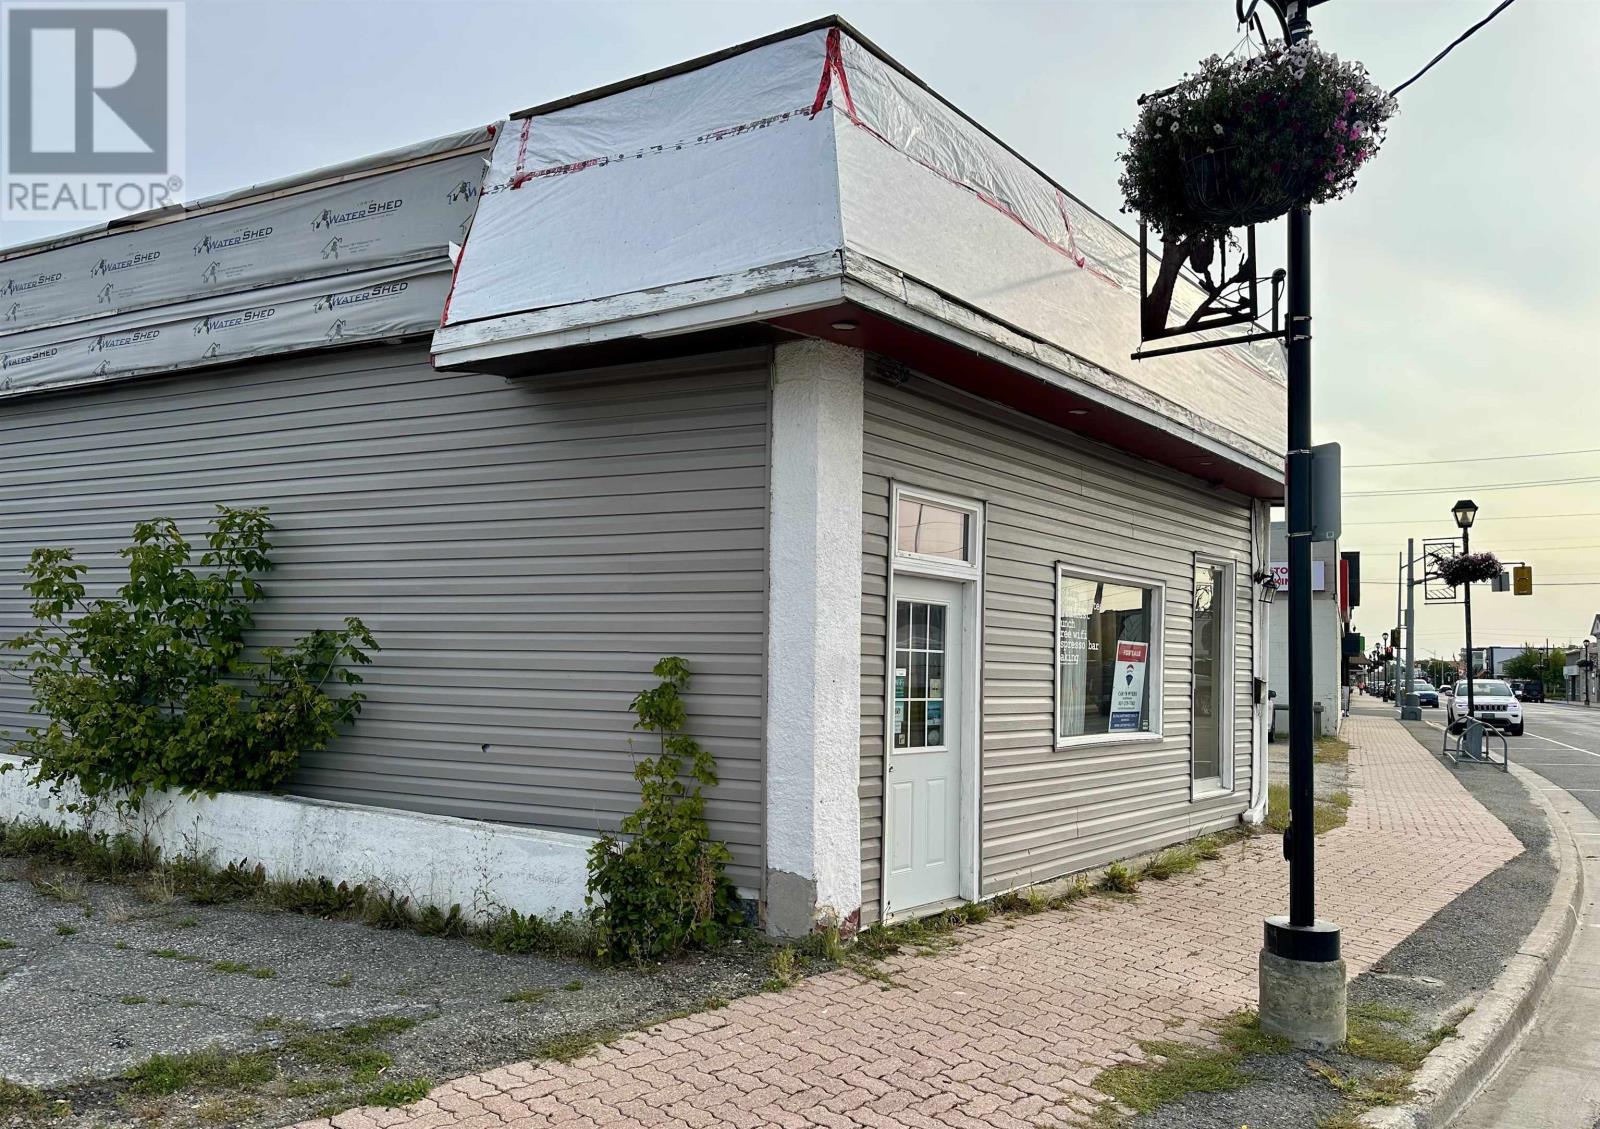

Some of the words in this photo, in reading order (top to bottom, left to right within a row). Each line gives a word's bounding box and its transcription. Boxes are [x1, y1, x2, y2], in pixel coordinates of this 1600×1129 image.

[1060, 619, 1076, 629] unch
[1060, 630, 1072, 639] ree
[1060, 640, 1086, 651] spresso
[1088, 640, 1099, 650] bar
[1060, 651, 1080, 665] aking
